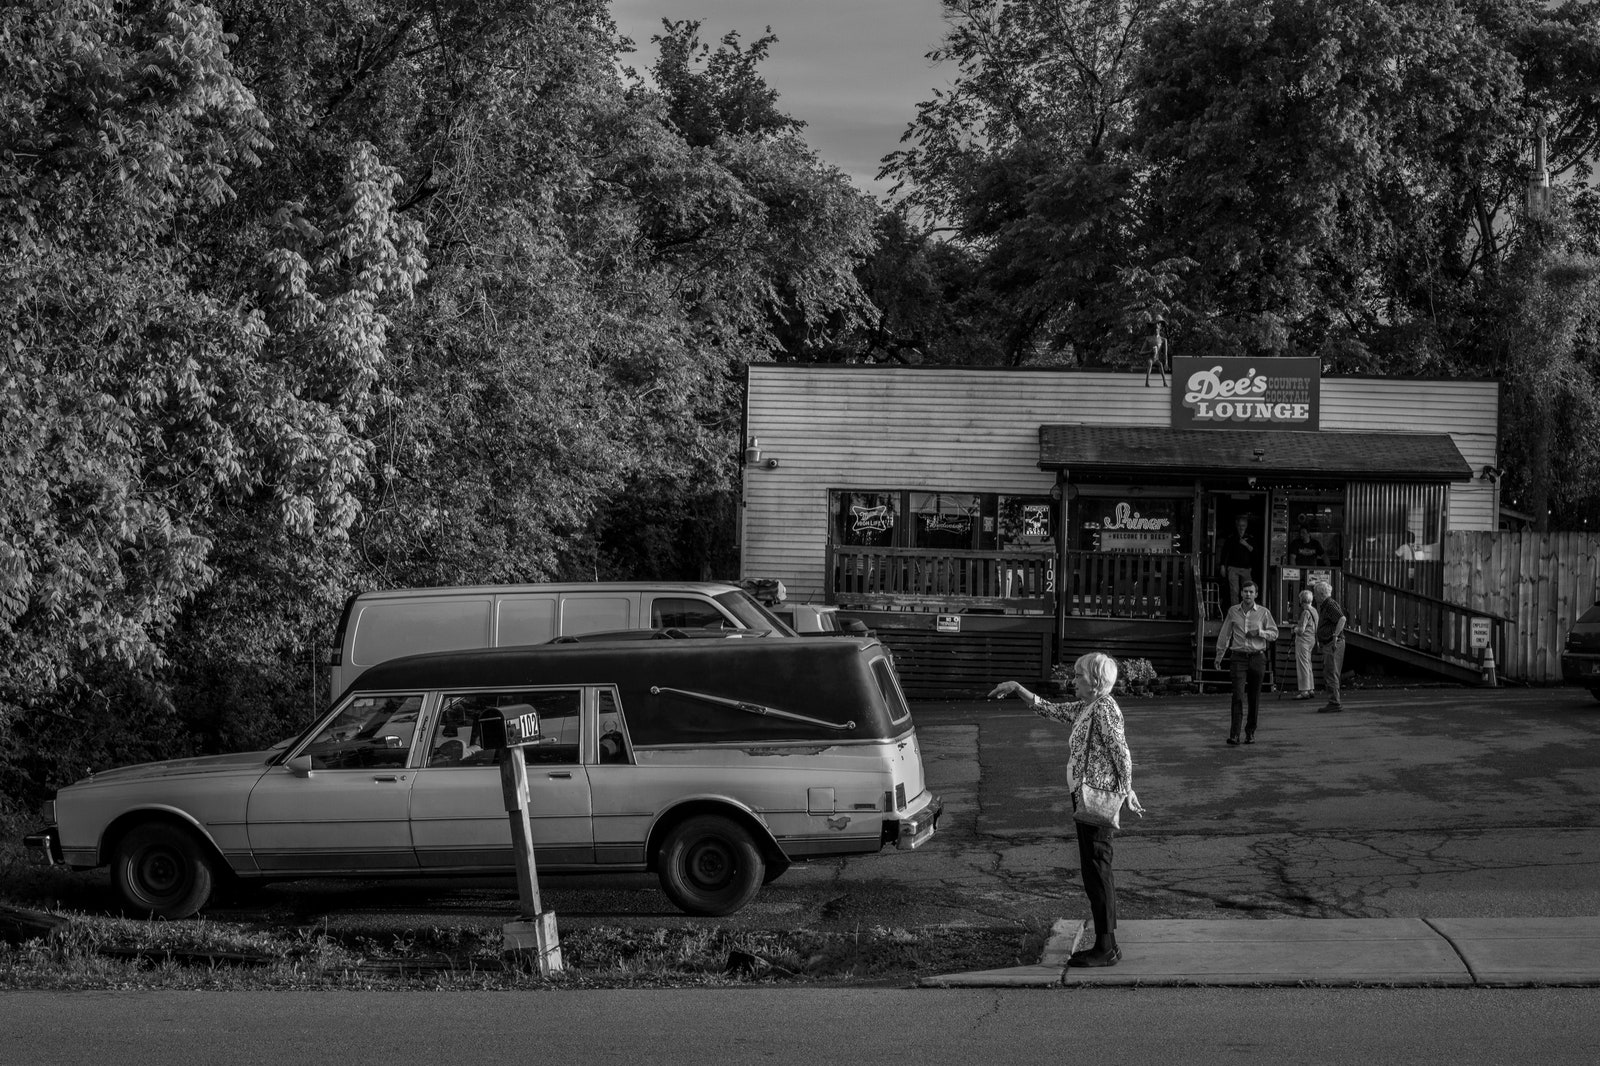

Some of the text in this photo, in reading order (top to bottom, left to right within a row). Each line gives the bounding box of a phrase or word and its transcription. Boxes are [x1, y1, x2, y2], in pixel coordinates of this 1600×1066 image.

[1184, 366, 1268, 403] Dee's
[1268, 377, 1311, 389] COUNTRY
[1266, 391, 1311, 403] COCKTAIL
[1196, 402, 1310, 419] LOUNGE
[1103, 502, 1170, 530] Shiner
[521, 714, 539, 736] 102
